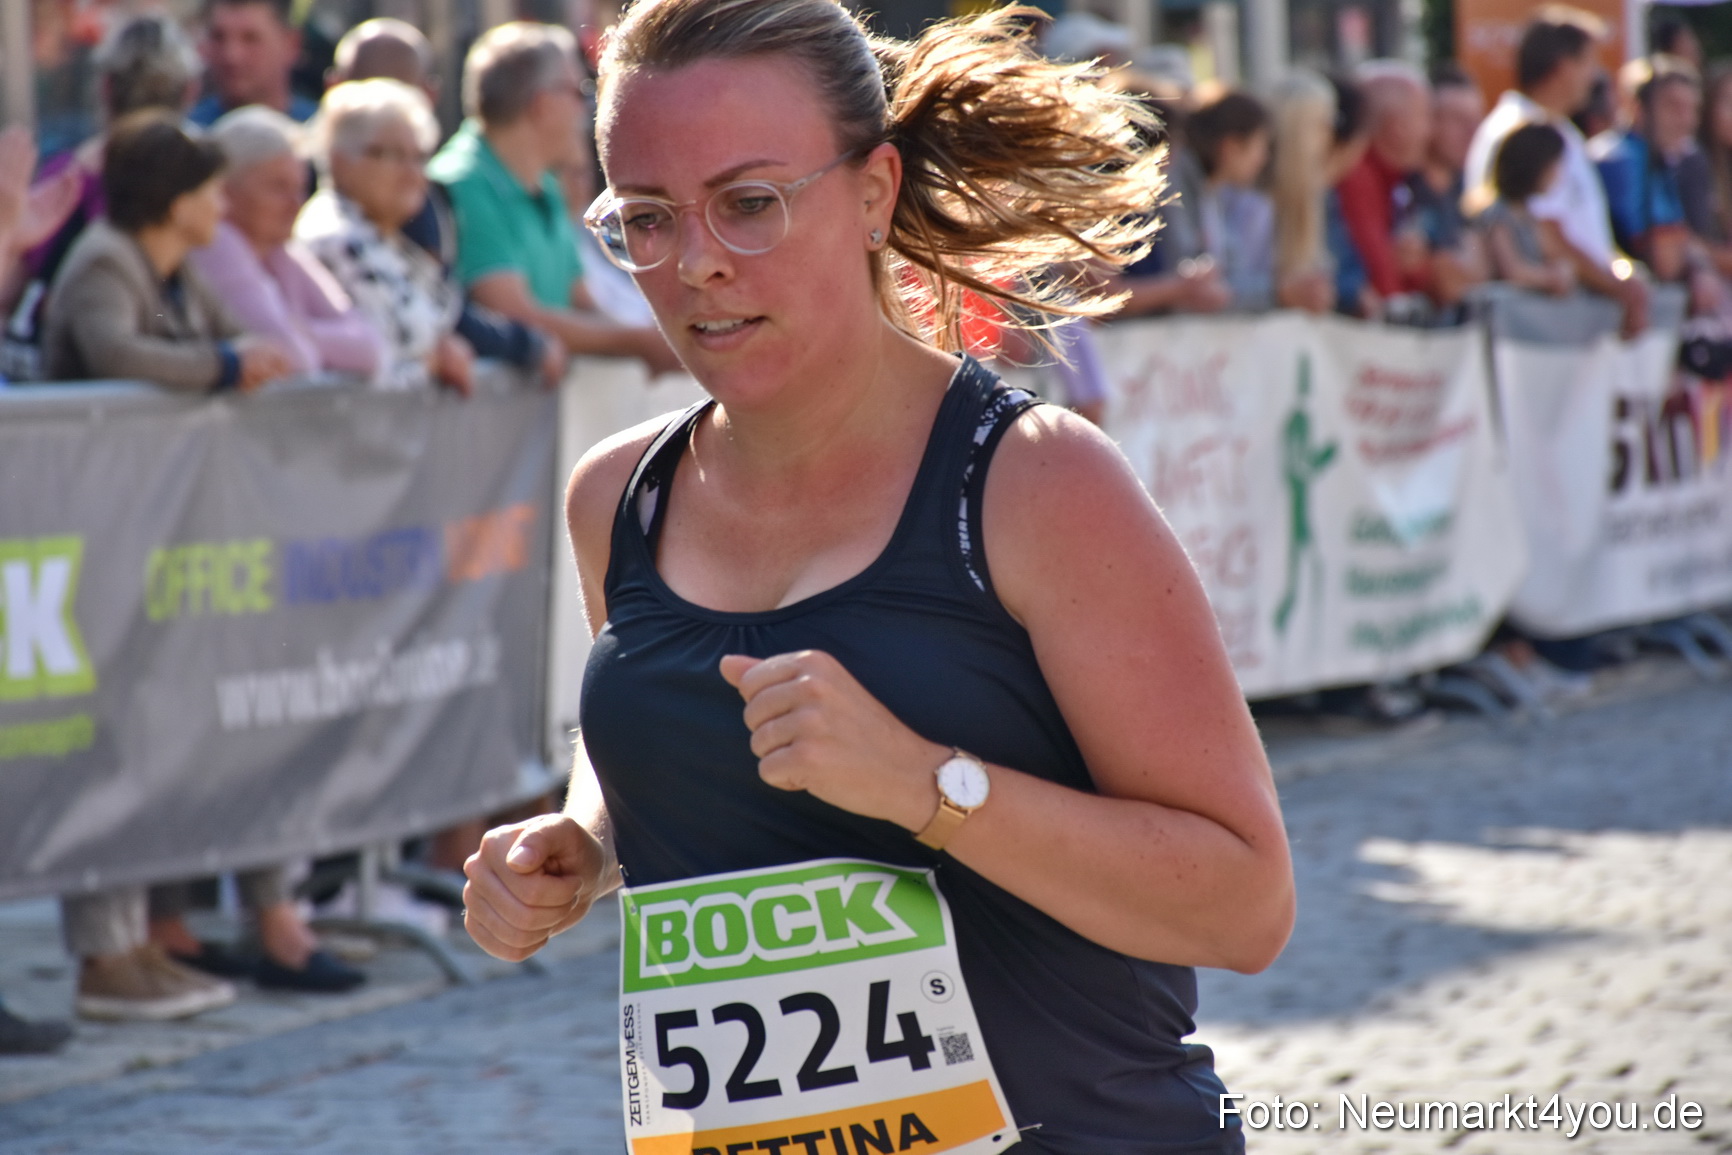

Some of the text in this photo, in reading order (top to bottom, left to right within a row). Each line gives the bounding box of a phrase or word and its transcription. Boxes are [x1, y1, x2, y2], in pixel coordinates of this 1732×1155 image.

[145, 539, 274, 622] OFFICE
[640, 873, 917, 978] BOCK
[929, 978, 946, 995] S
[654, 980, 936, 1111] 5224
[691, 1112, 939, 1155] TINA
